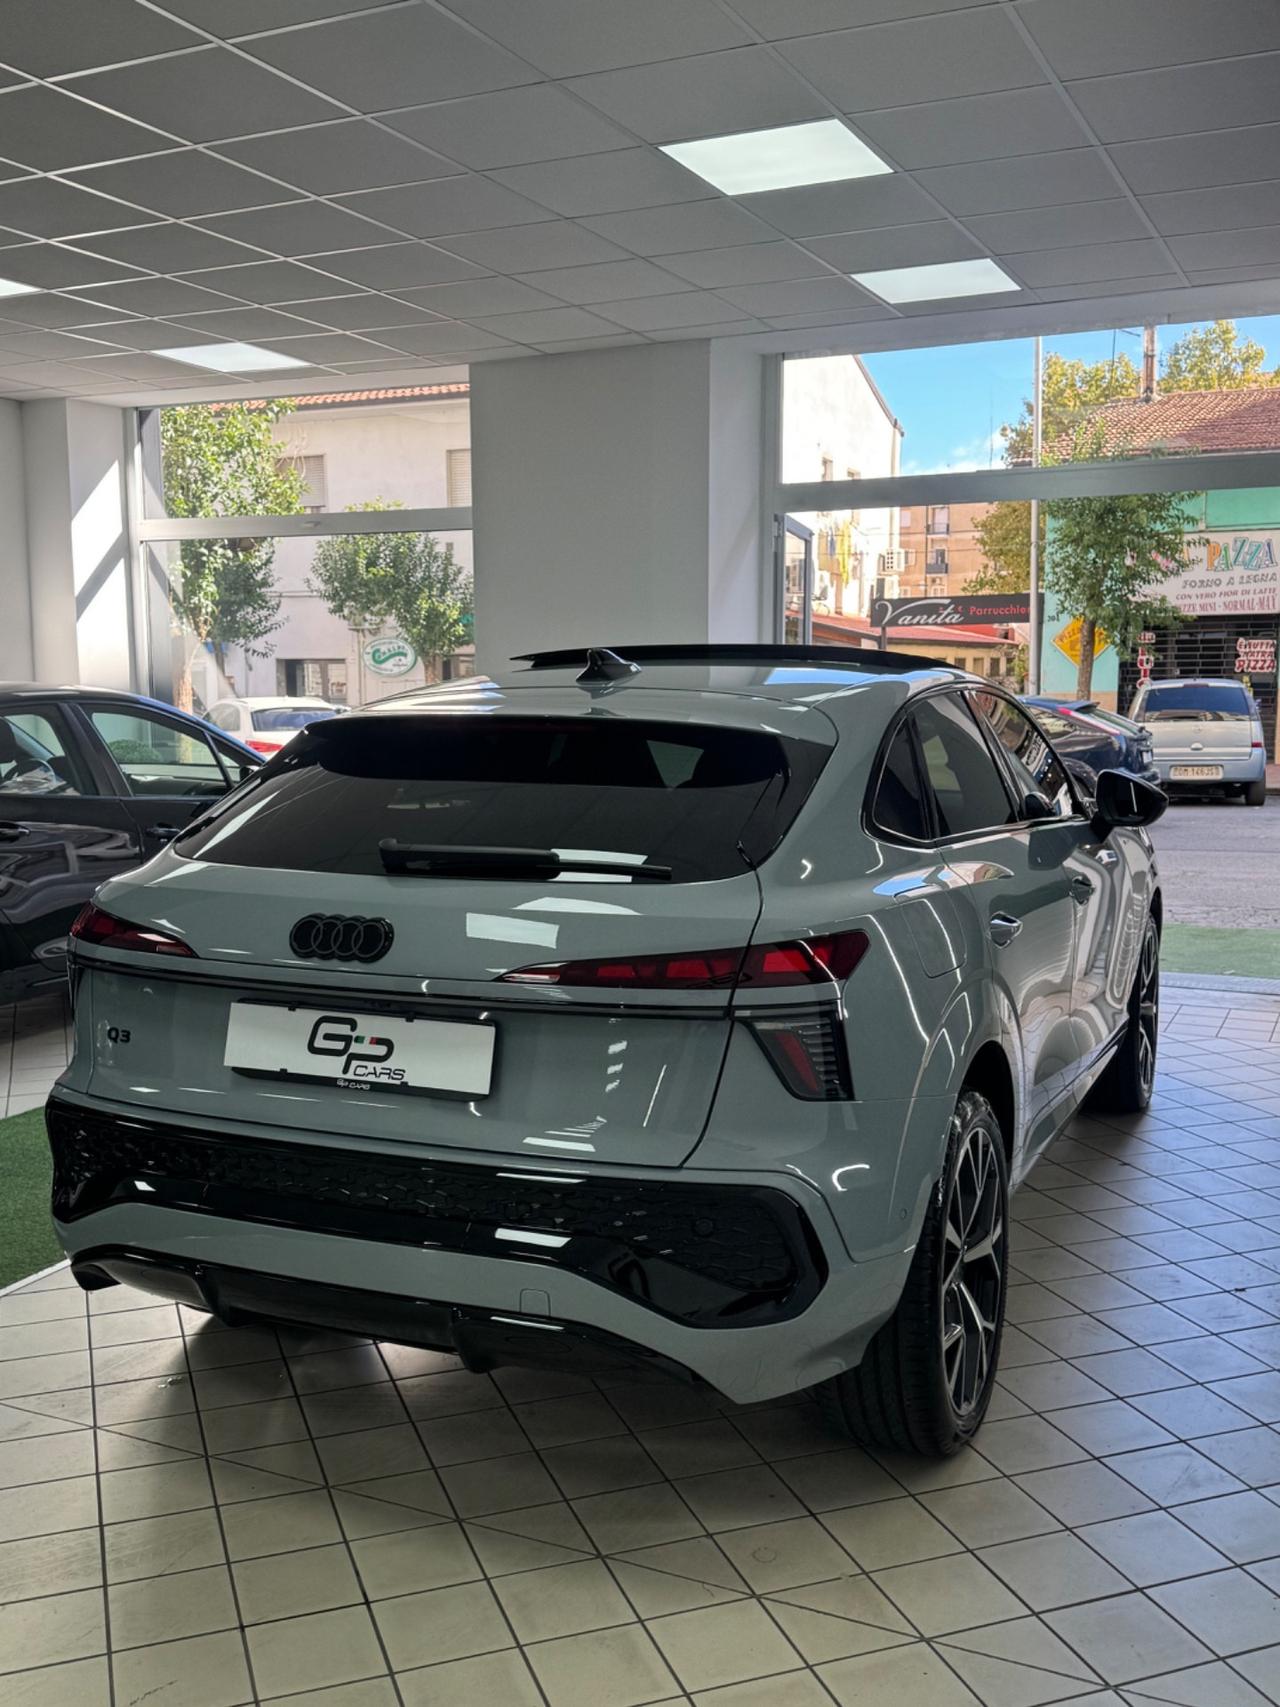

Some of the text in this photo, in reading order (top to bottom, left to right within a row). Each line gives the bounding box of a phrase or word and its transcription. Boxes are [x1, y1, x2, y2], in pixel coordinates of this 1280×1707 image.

[1206, 537, 1278, 572] PAZZA
[1182, 572, 1277, 589] FORNO A LEGNA
[1175, 586, 1277, 601] CON VERO FIOR DI LATTE
[1235, 659, 1277, 671] PIZZA
[107, 1026, 131, 1044] Q3
[353, 1065, 406, 1080] CARS
